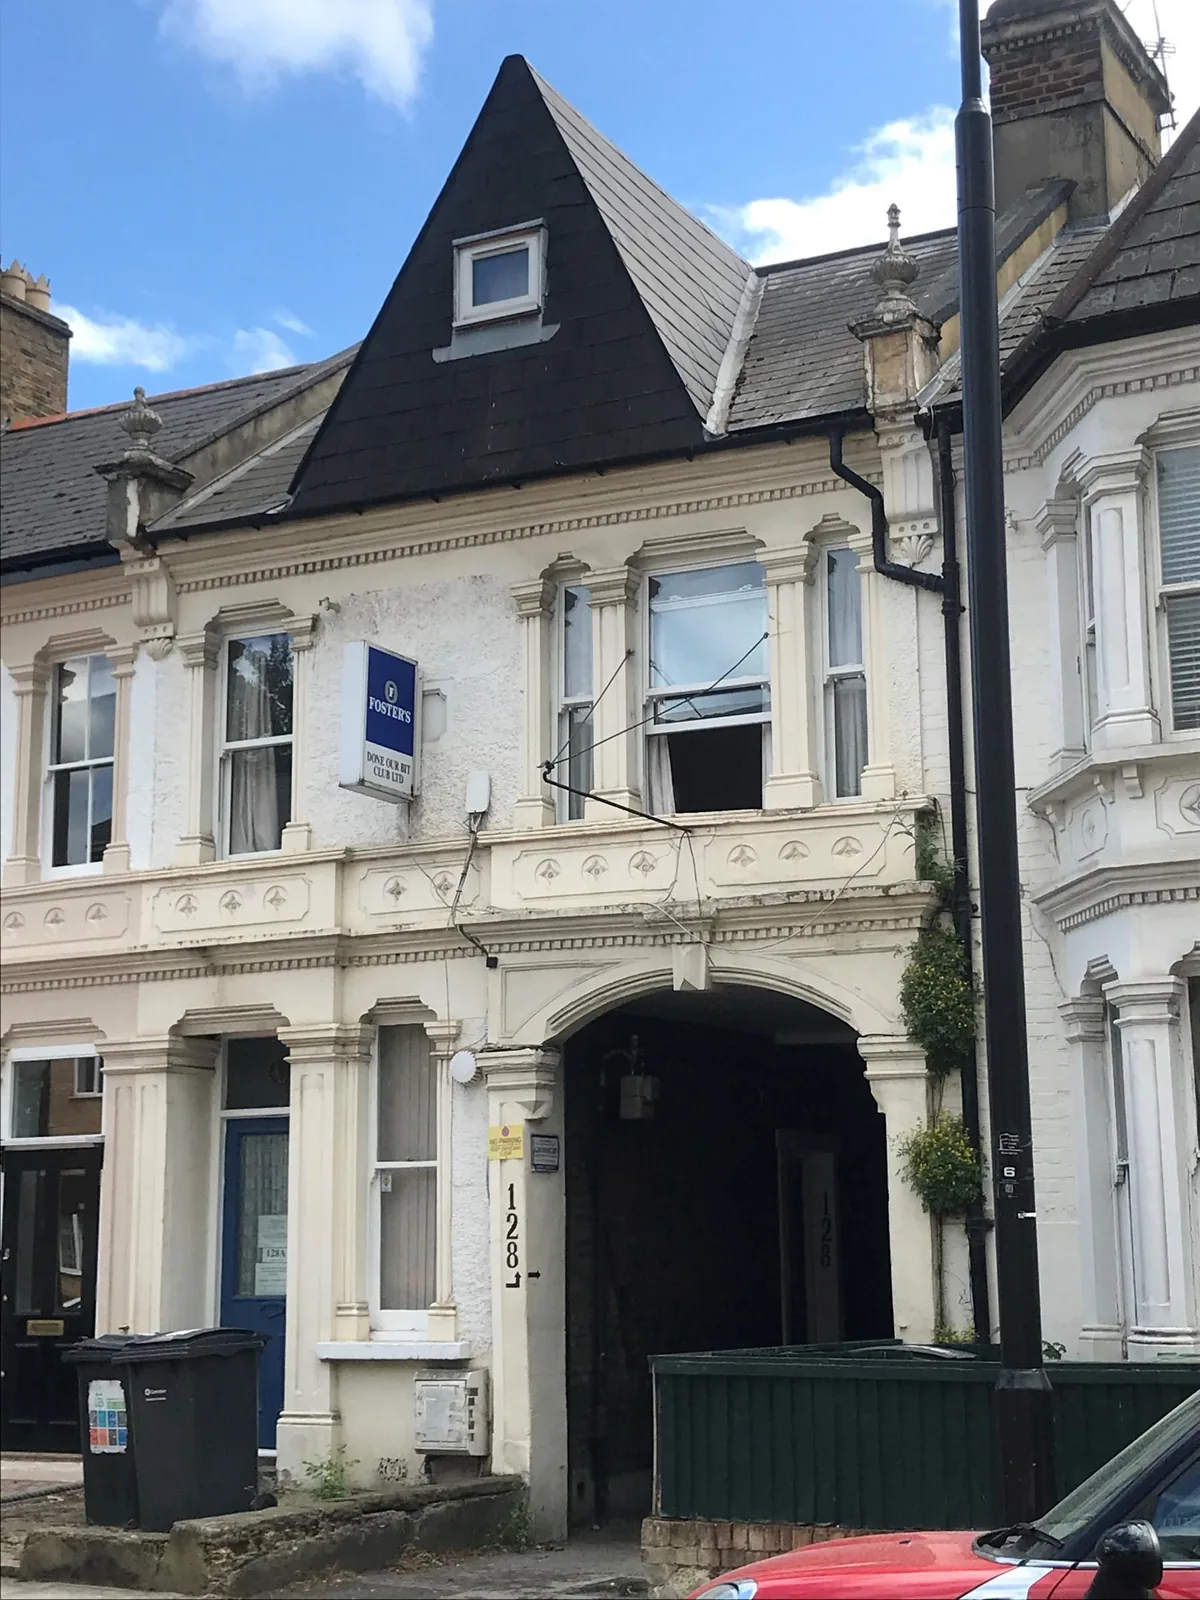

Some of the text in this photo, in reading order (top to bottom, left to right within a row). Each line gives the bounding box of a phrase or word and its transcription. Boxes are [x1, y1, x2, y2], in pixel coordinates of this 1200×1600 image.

[388, 686, 395, 697] F
[369, 696, 412, 724] FOSTER'S
[367, 751, 411, 775] DONE OUR BIT
[373, 765, 404, 784] CLUB LTD
[1003, 1166, 1016, 1177] 6
[506, 1183, 519, 1269] 128
[266, 1249, 286, 1258] 128A
